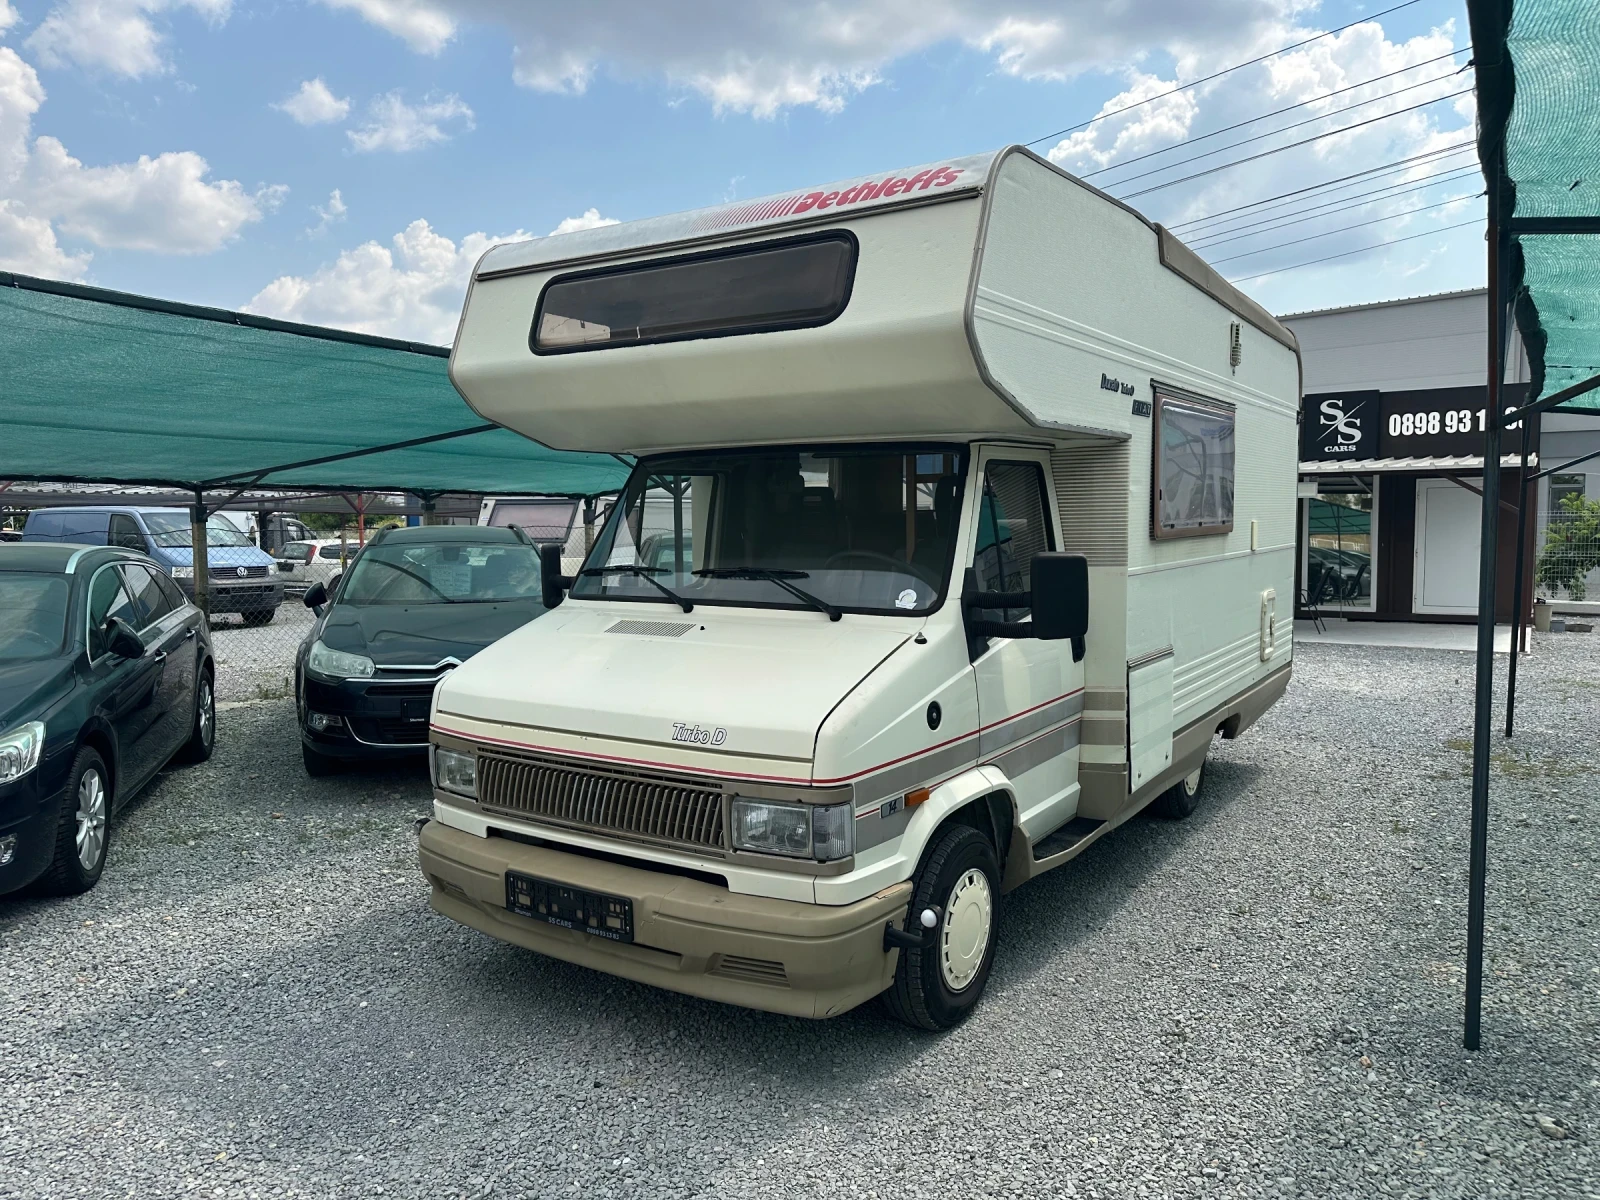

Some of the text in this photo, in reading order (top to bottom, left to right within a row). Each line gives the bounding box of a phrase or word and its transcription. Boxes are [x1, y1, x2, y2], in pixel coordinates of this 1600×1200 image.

[792, 166, 965, 215] Dethleffs
[1134, 401, 1151, 415] FIAT
[1388, 411, 1441, 436] 0898
[1445, 409, 1472, 434] 93
[1324, 445, 1357, 453] CARS
[672, 722, 728, 746] Turbo D
[888, 800, 898, 814] 14
[556, 919, 572, 929] CARS
